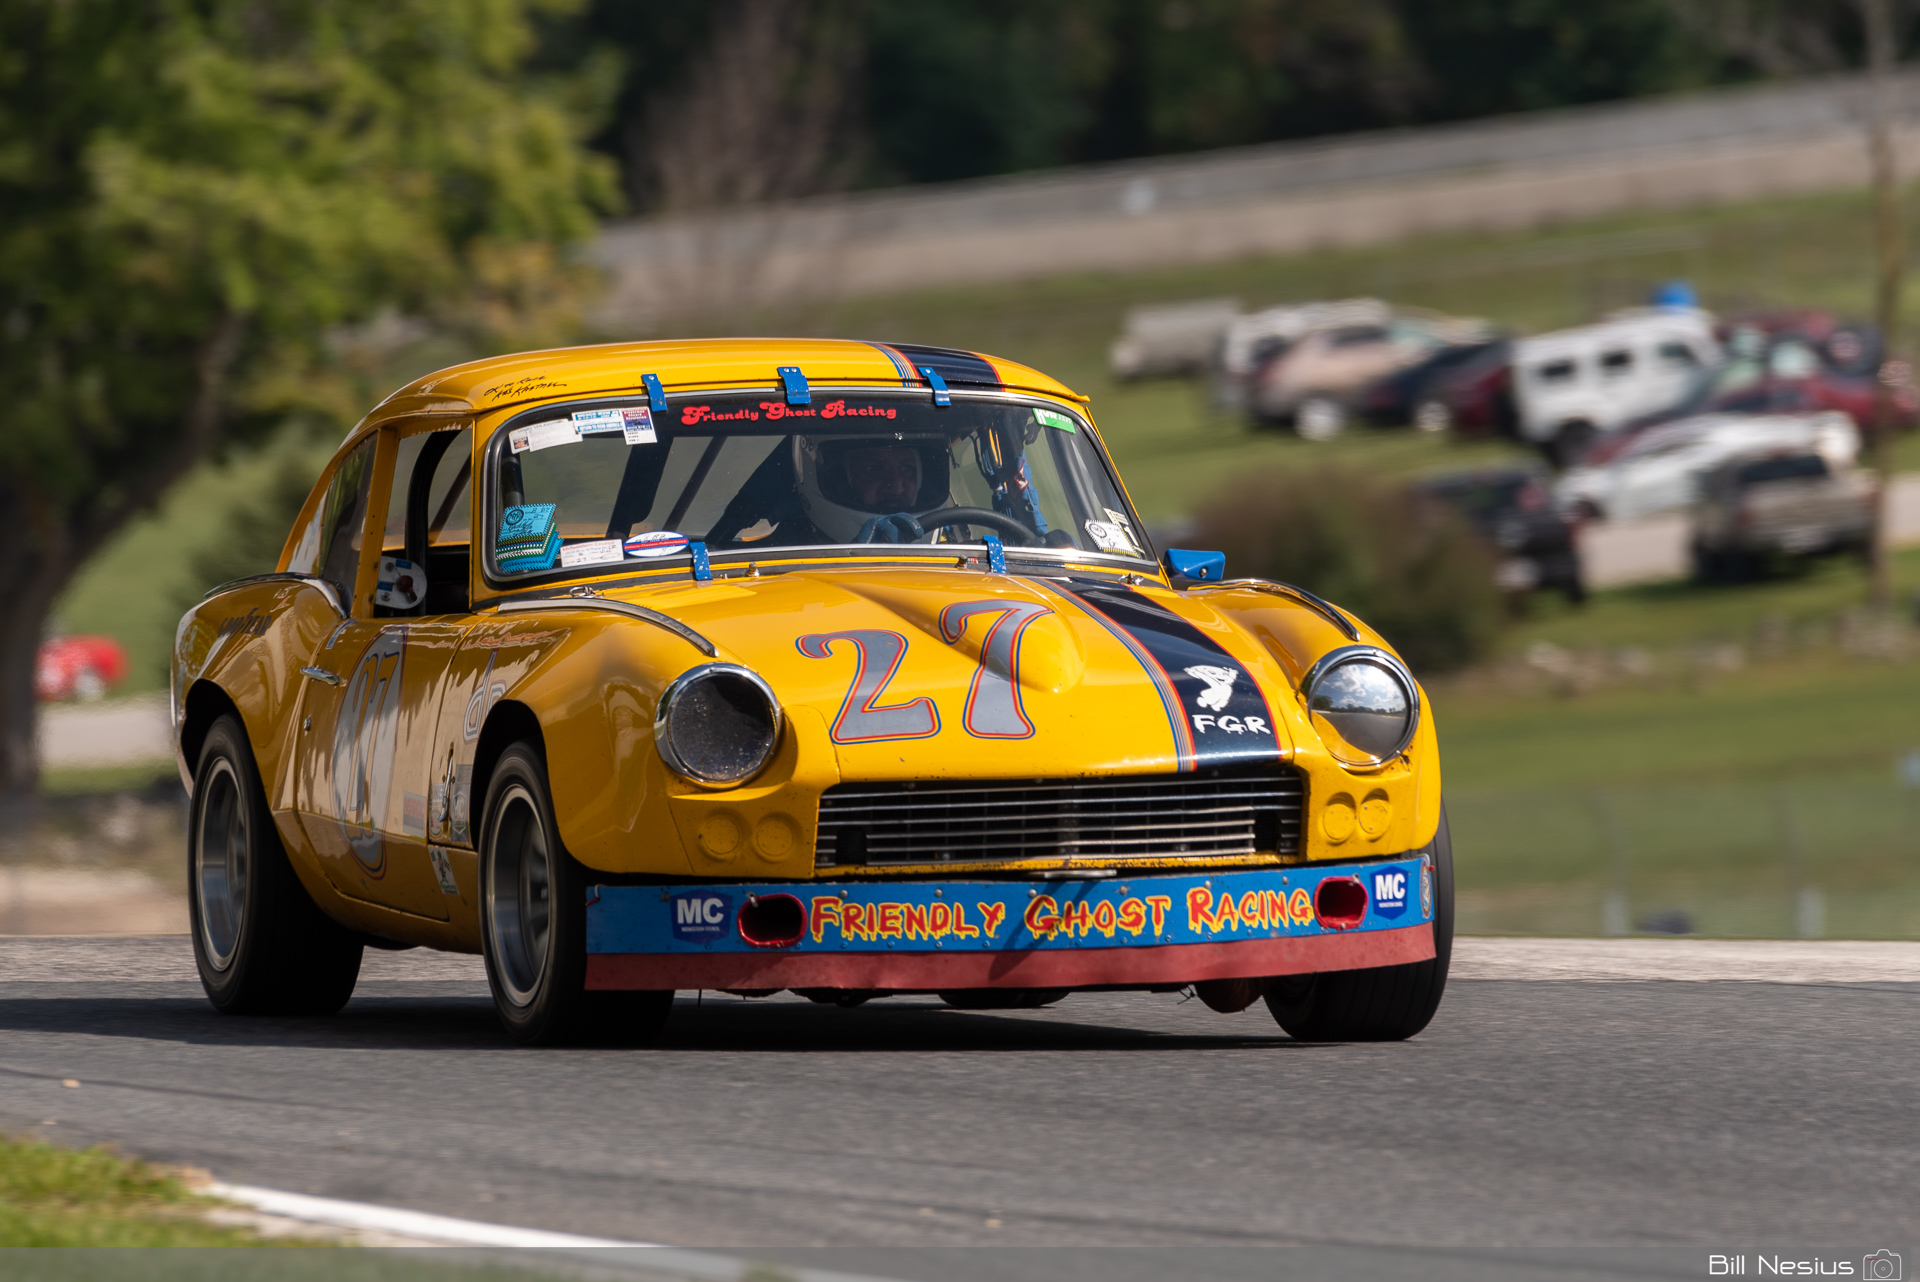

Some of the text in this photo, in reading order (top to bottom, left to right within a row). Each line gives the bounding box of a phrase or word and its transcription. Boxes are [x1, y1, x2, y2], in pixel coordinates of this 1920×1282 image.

[680, 399, 896, 425] Friendly Ghost Racing
[795, 599, 1055, 745] 27
[1191, 714, 1272, 735] FGR
[350, 651, 400, 845] 27
[1375, 873, 1406, 900] MC
[677, 897, 725, 925] MC
[811, 886, 1315, 943] FRIENDLY GHOST RACING
